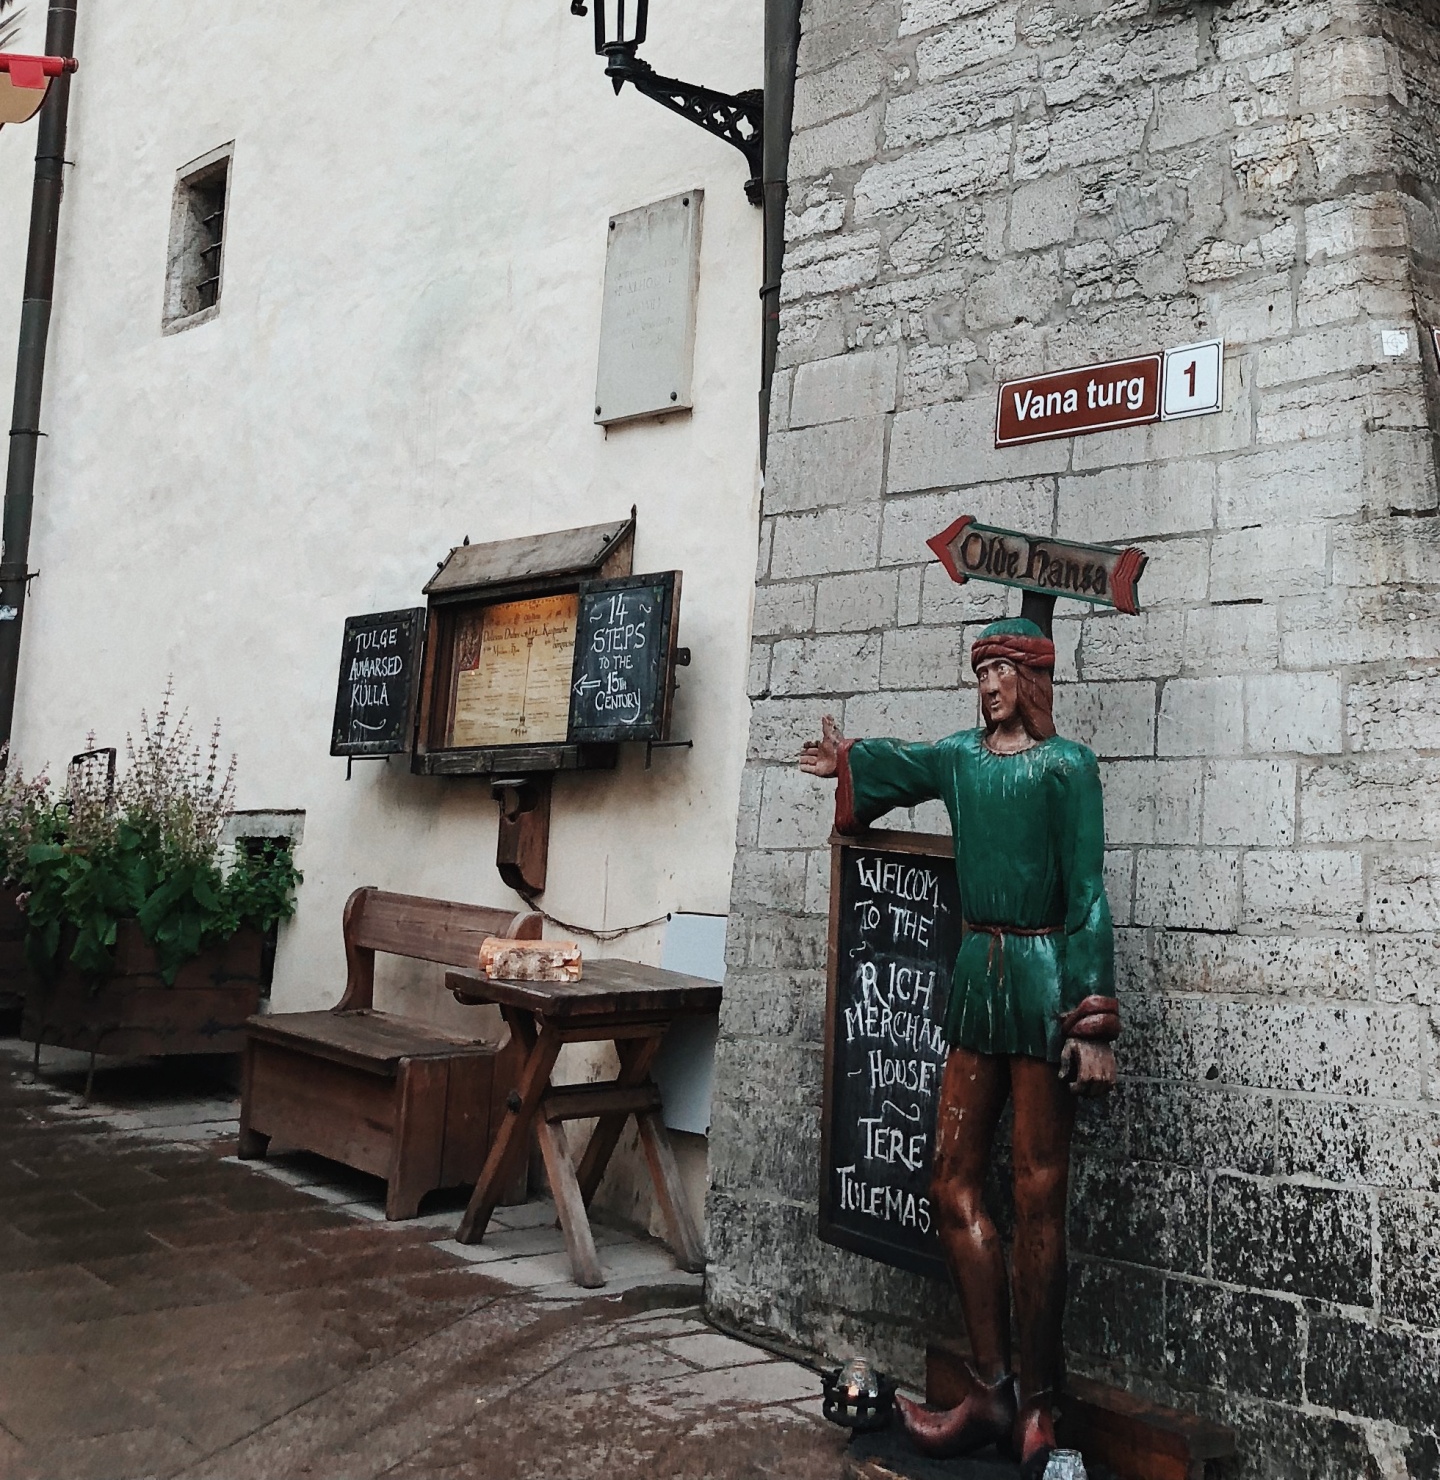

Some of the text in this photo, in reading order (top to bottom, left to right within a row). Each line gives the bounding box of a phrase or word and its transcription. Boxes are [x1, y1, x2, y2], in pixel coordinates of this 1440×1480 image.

[1014, 375, 1145, 422] Vana turg
[1183, 360, 1197, 398] 1
[960, 532, 1020, 578] Olde
[607, 592, 629, 626] 14
[355, 628, 398, 653] TULGE
[591, 621, 646, 653] STEPS
[599, 654, 633, 669] TO THE
[856, 857, 950, 915] WELCOM
[854, 900, 934, 948] TO THE
[860, 961, 936, 1010] RICH
[844, 1001, 951, 1068] MERCHAN
[868, 1049, 936, 1097] HOUSE
[858, 1116, 927, 1172] TERE
[836, 1163, 939, 1237] TULEMAS
